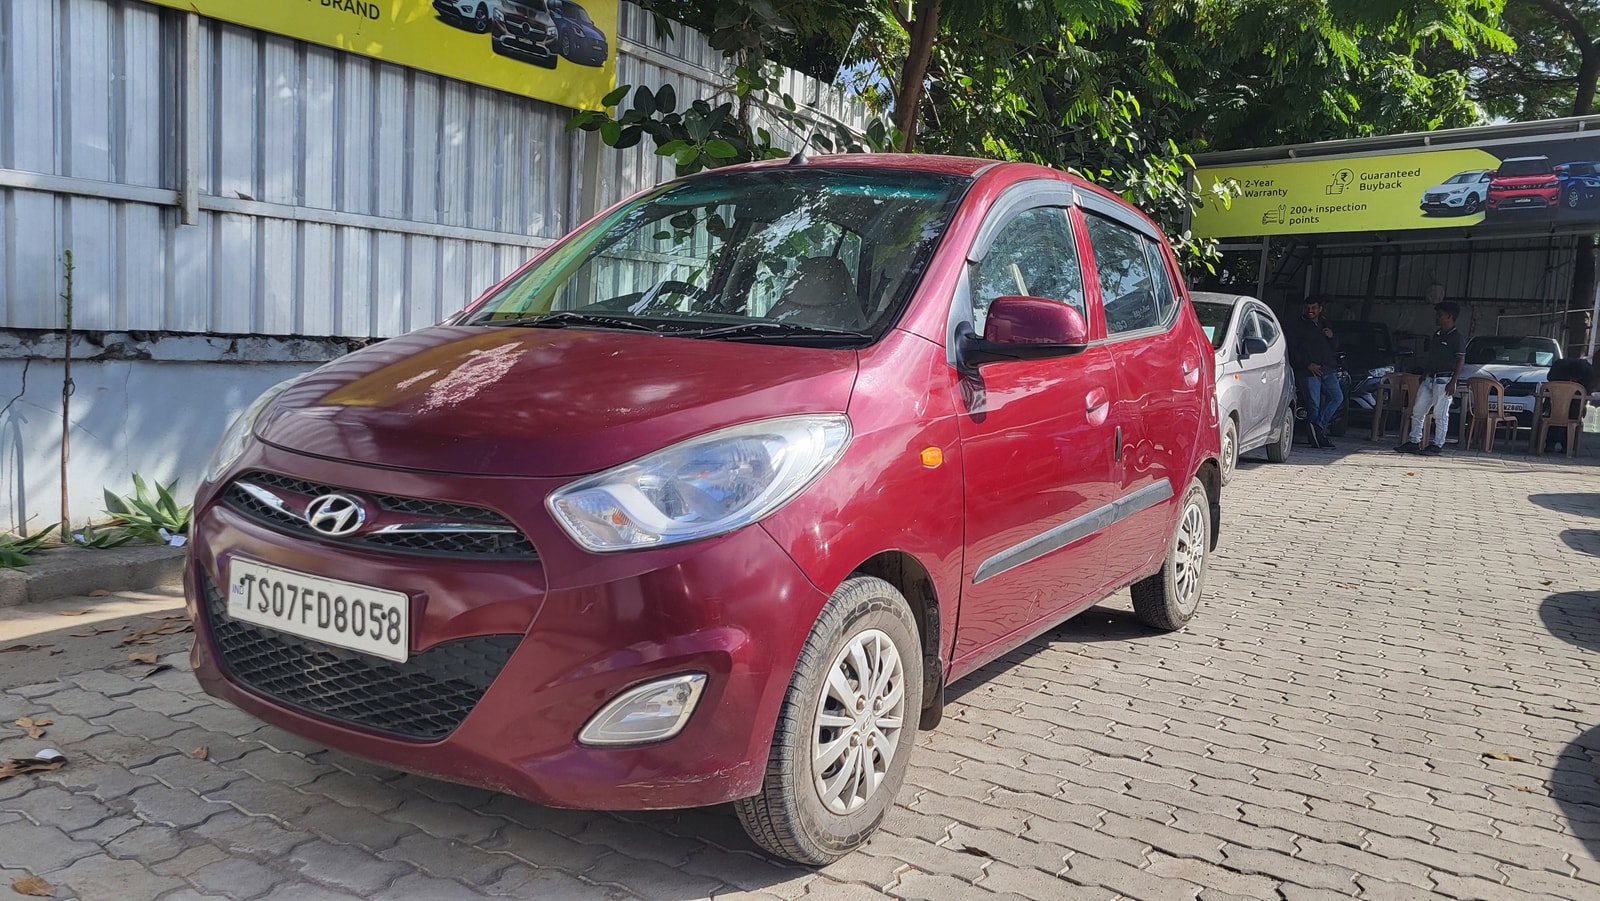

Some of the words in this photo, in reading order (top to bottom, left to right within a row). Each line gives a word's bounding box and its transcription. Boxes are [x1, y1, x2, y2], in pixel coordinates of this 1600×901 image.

[1360, 168, 1421, 180] Guaranteed
[1245, 179, 1274, 188] 2-Year
[1359, 179, 1402, 191] Buyback
[1244, 187, 1288, 198] Warranty
[1290, 206, 1313, 215] 200+
[1316, 203, 1367, 214] inspection
[1289, 215, 1320, 226] points
[244, 573, 401, 645] TS07FD8058
